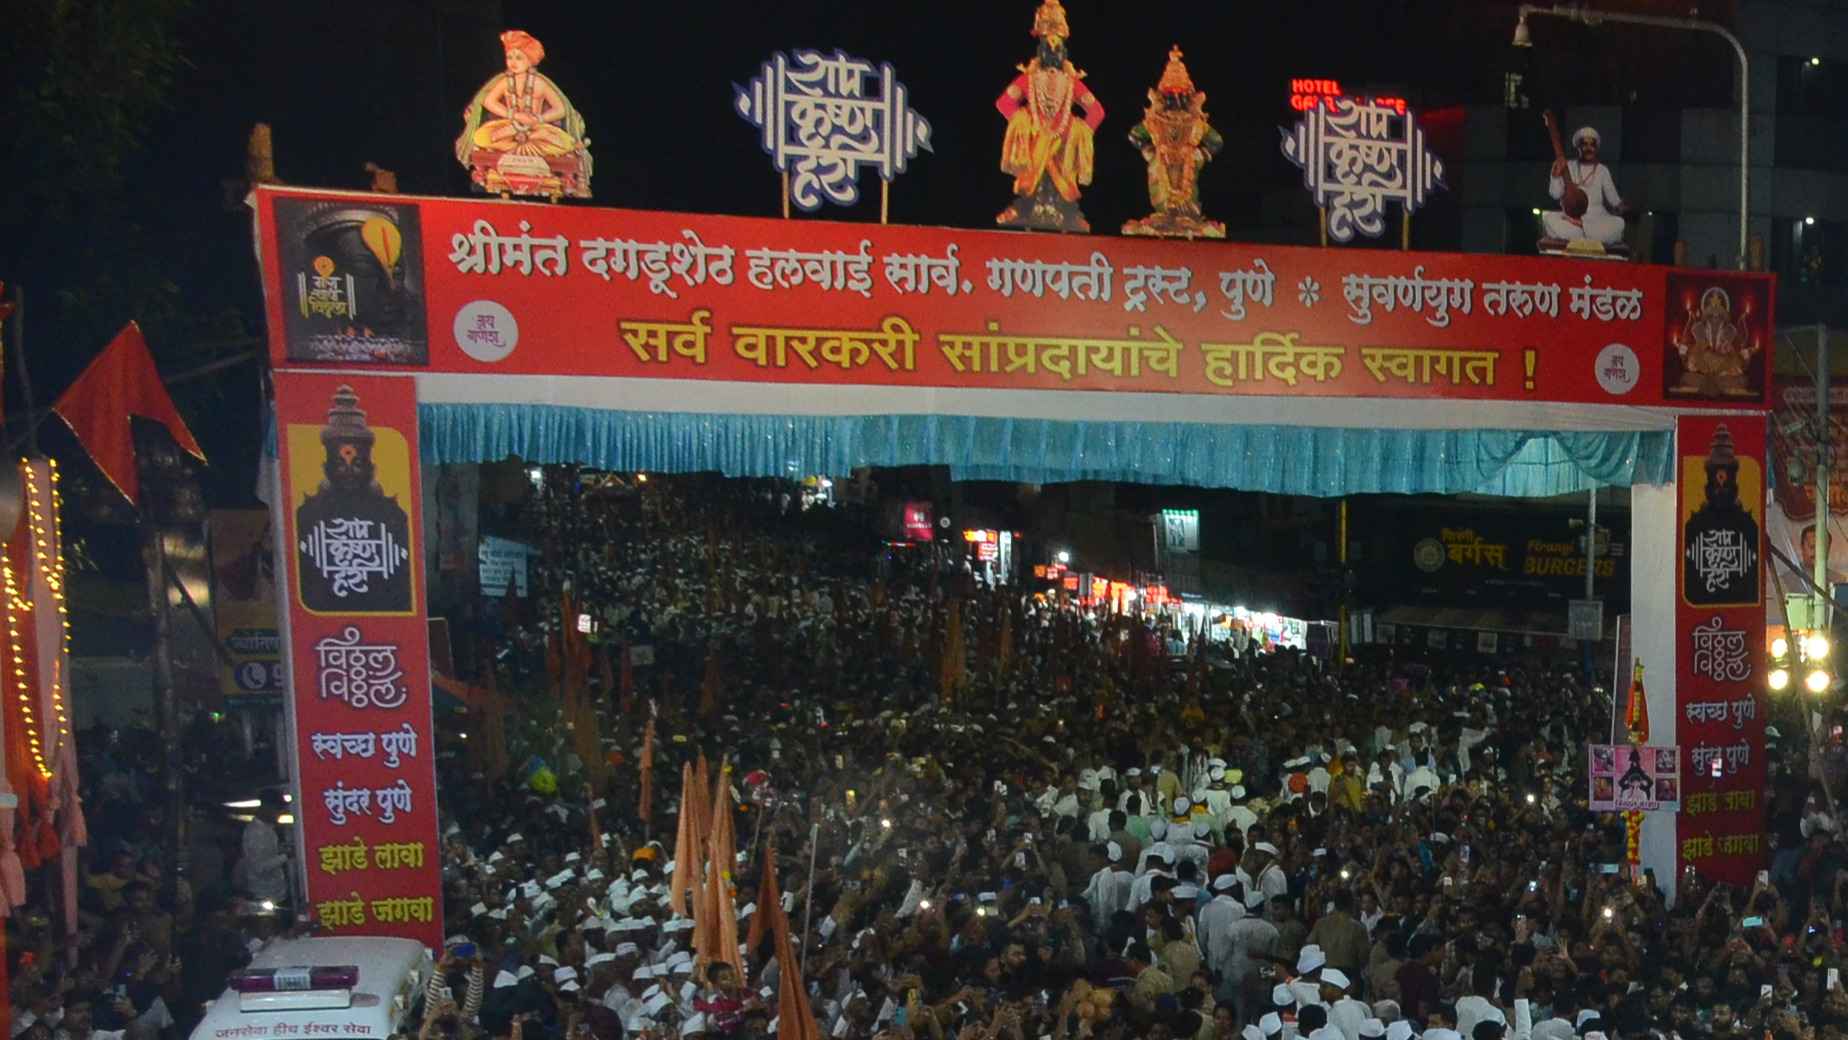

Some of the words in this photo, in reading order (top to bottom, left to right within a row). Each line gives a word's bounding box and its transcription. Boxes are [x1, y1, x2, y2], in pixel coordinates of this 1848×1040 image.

[1292, 79, 1341, 95] HOTEL
[447, 219, 567, 277] श्रीमंत
[580, 230, 735, 298] दगडूशेठ
[746, 239, 872, 298] हलवाई
[986, 250, 1113, 301] गणपती
[1219, 258, 1275, 322] पुणे
[1342, 266, 1473, 327] सुवर्णयुग
[1482, 280, 1560, 319] तरुण
[1569, 275, 1643, 321] मंडळ
[620, 310, 711, 362] सर्व
[733, 316, 919, 371] वारकरी
[940, 323, 1183, 380] सांप्रदायांचे
[1201, 333, 1344, 388] हार्दिक
[1362, 345, 1498, 386] स्वागत
[1686, 700, 1728, 724] स्वच्छ
[1732, 693, 1756, 729] पुणे
[312, 732, 376, 761] स्वच्छ
[381, 723, 418, 768] पुणे
[1726, 738, 1750, 775] पुणे
[323, 782, 371, 826] सुंदर
[377, 779, 413, 824] पुणे
[1686, 786, 1719, 816] झाडे
[319, 836, 368, 874] झाडे
[374, 842, 424, 871] लावा
[1682, 830, 1714, 861] झाडे
[317, 891, 365, 930] झाडे
[371, 896, 434, 923] जगवा
[215, 1024, 268, 1039] जनसेवा
[303, 1021, 338, 1036] ईश्वर
[344, 1021, 372, 1035] सेवा
